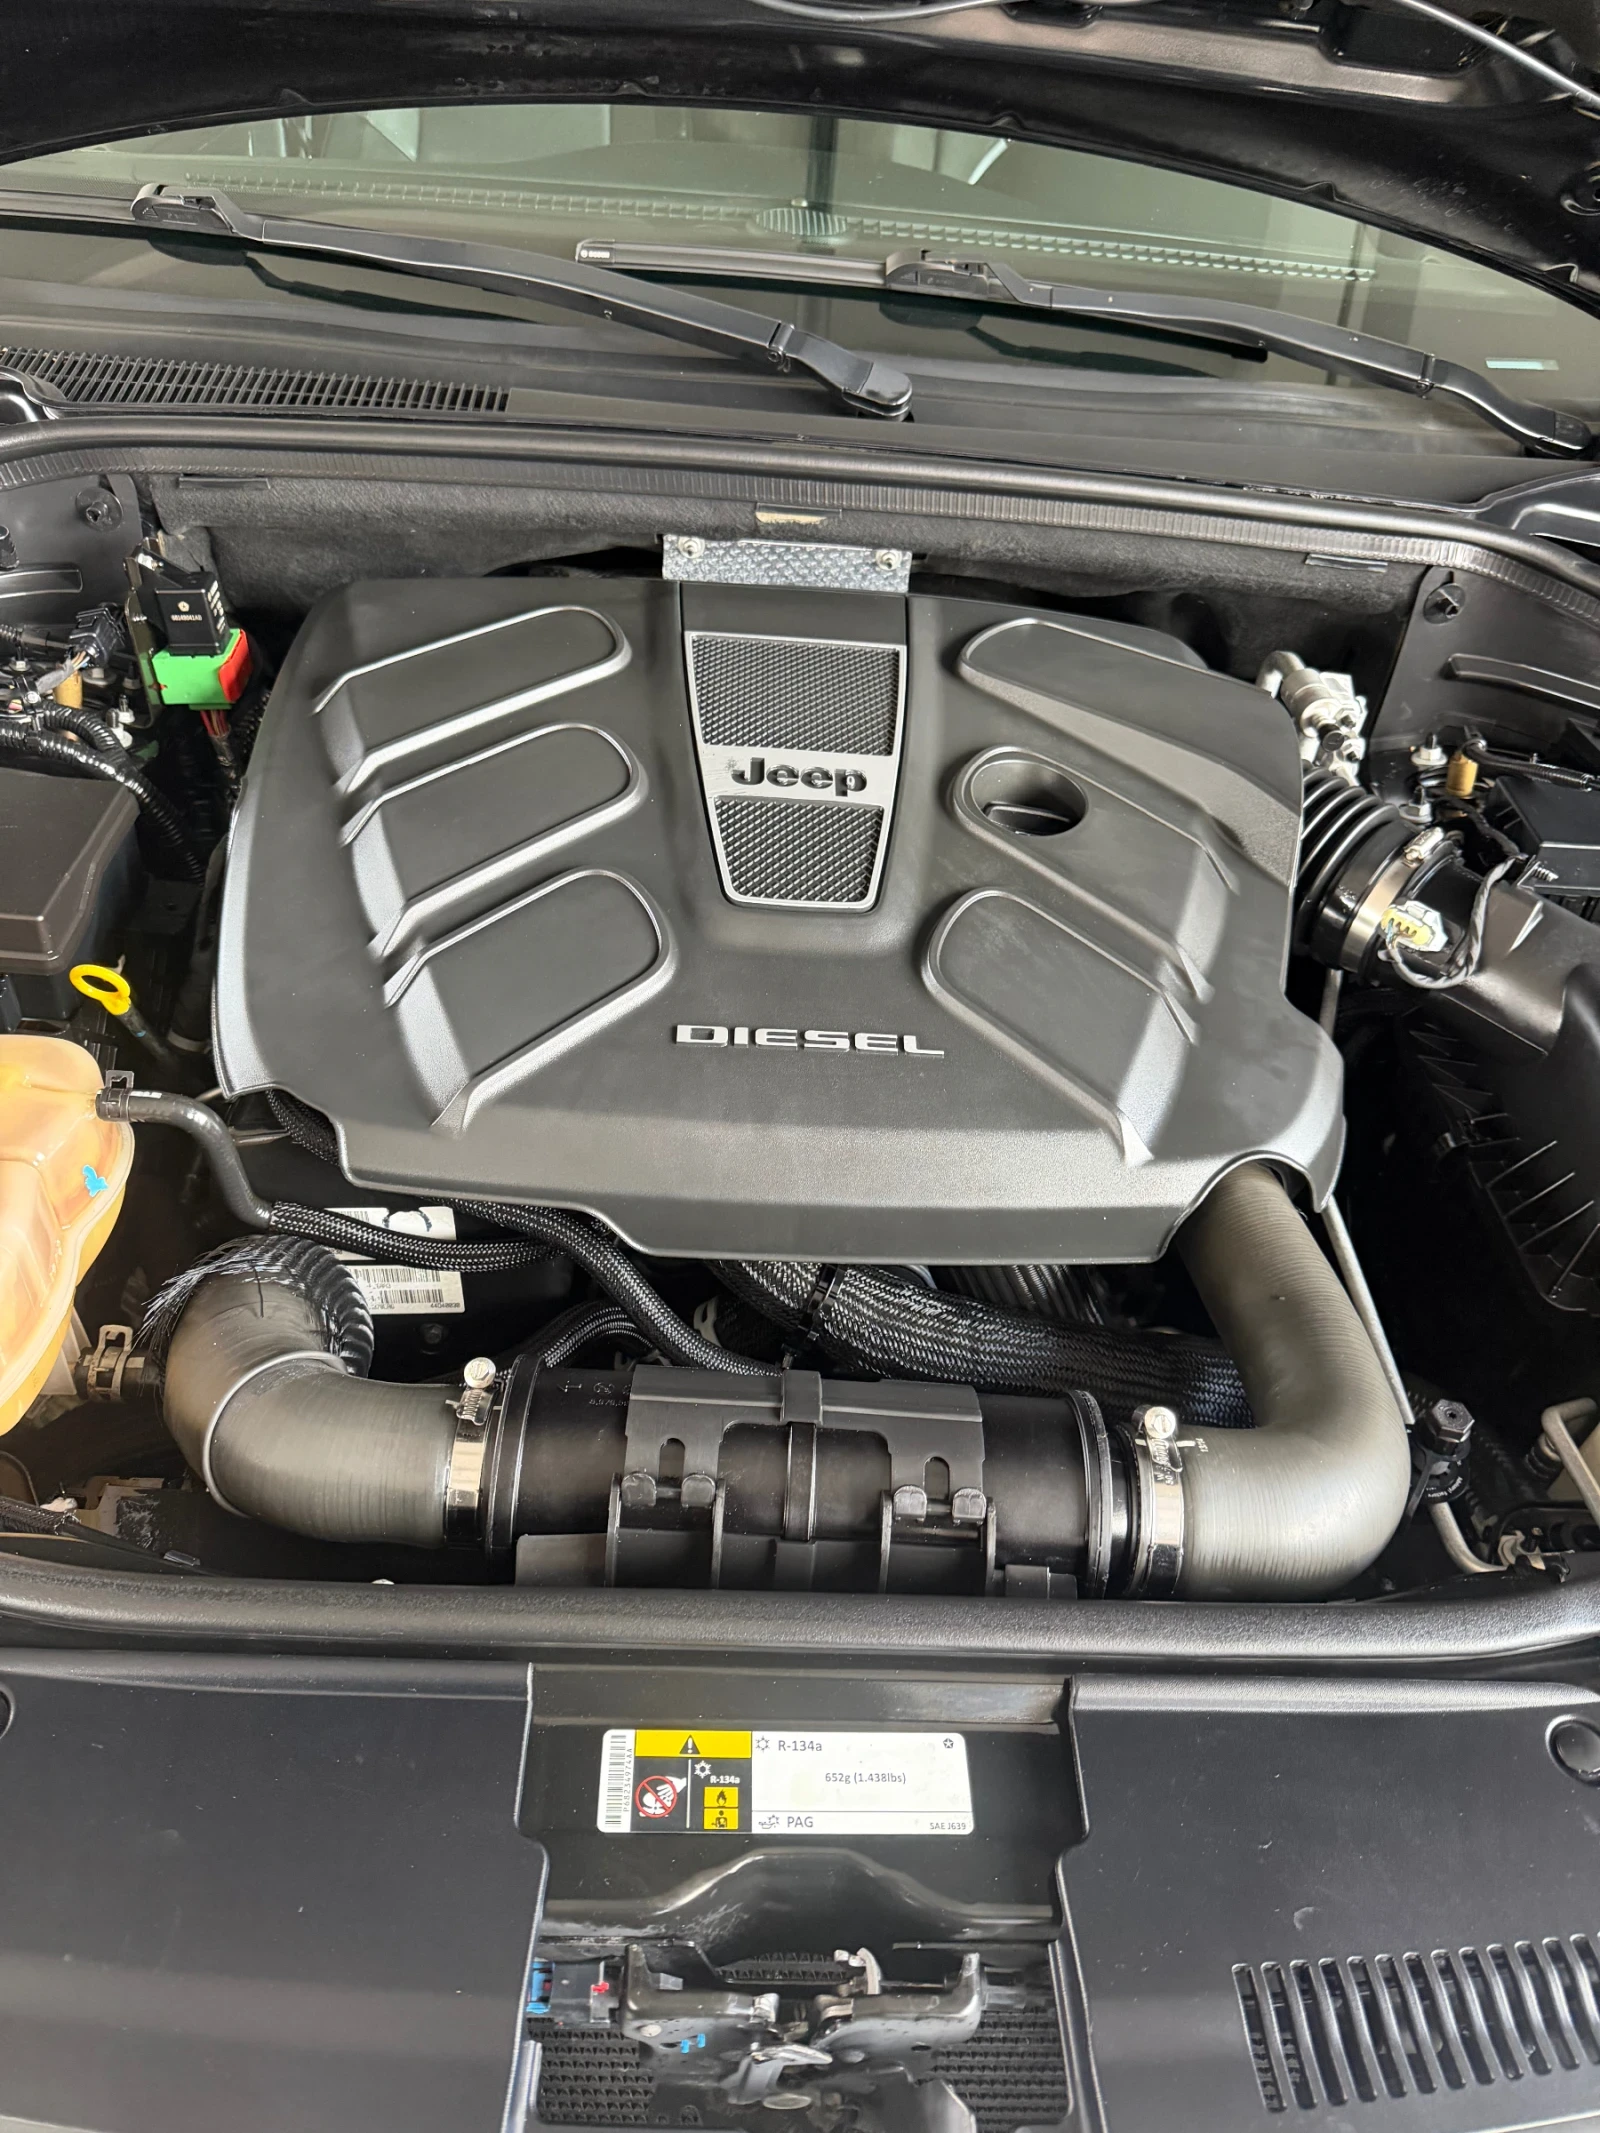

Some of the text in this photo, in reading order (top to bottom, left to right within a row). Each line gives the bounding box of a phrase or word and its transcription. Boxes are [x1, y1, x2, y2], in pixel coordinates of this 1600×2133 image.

[731, 757, 867, 796] Jeep
[675, 1024, 944, 1058] DIESEL
[778, 1740, 822, 1751] R-134a
[623, 1748, 632, 1812] P68234974AA
[710, 1775, 740, 1784] R-134a
[825, 1773, 906, 1784] 652g (1.438lbs)
[787, 1816, 814, 1828] PAG
[930, 1822, 966, 1830] SAE J639
